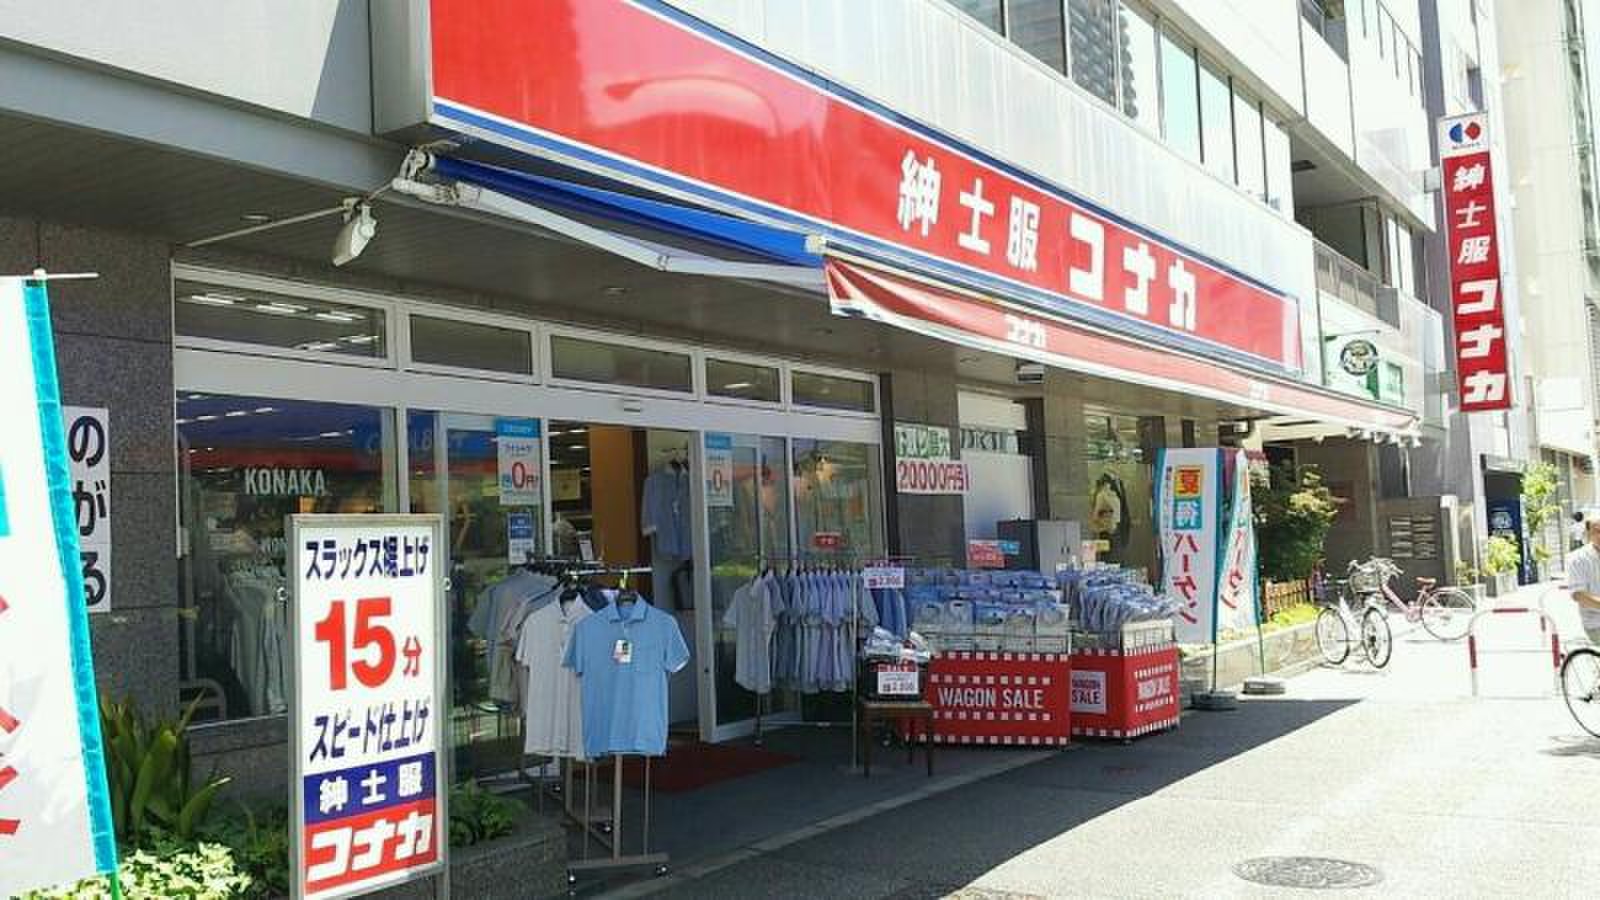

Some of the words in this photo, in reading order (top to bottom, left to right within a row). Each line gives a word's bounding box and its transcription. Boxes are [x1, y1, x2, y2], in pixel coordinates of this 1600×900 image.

[897, 149, 1041, 273] 紳士服
[1068, 211, 1197, 332] コナカ
[1453, 163, 1490, 260] 紳士服
[1457, 278, 1506, 404] コナカ
[244, 468, 325, 495] KONAKA
[314, 597, 422, 691] 15分
[310, 696, 430, 763] スピード仕上げ
[938, 687, 996, 708] WAGON
[1002, 688, 1045, 709] SALE
[319, 760, 422, 814] 紳士服
[306, 811, 433, 883] コナカ
